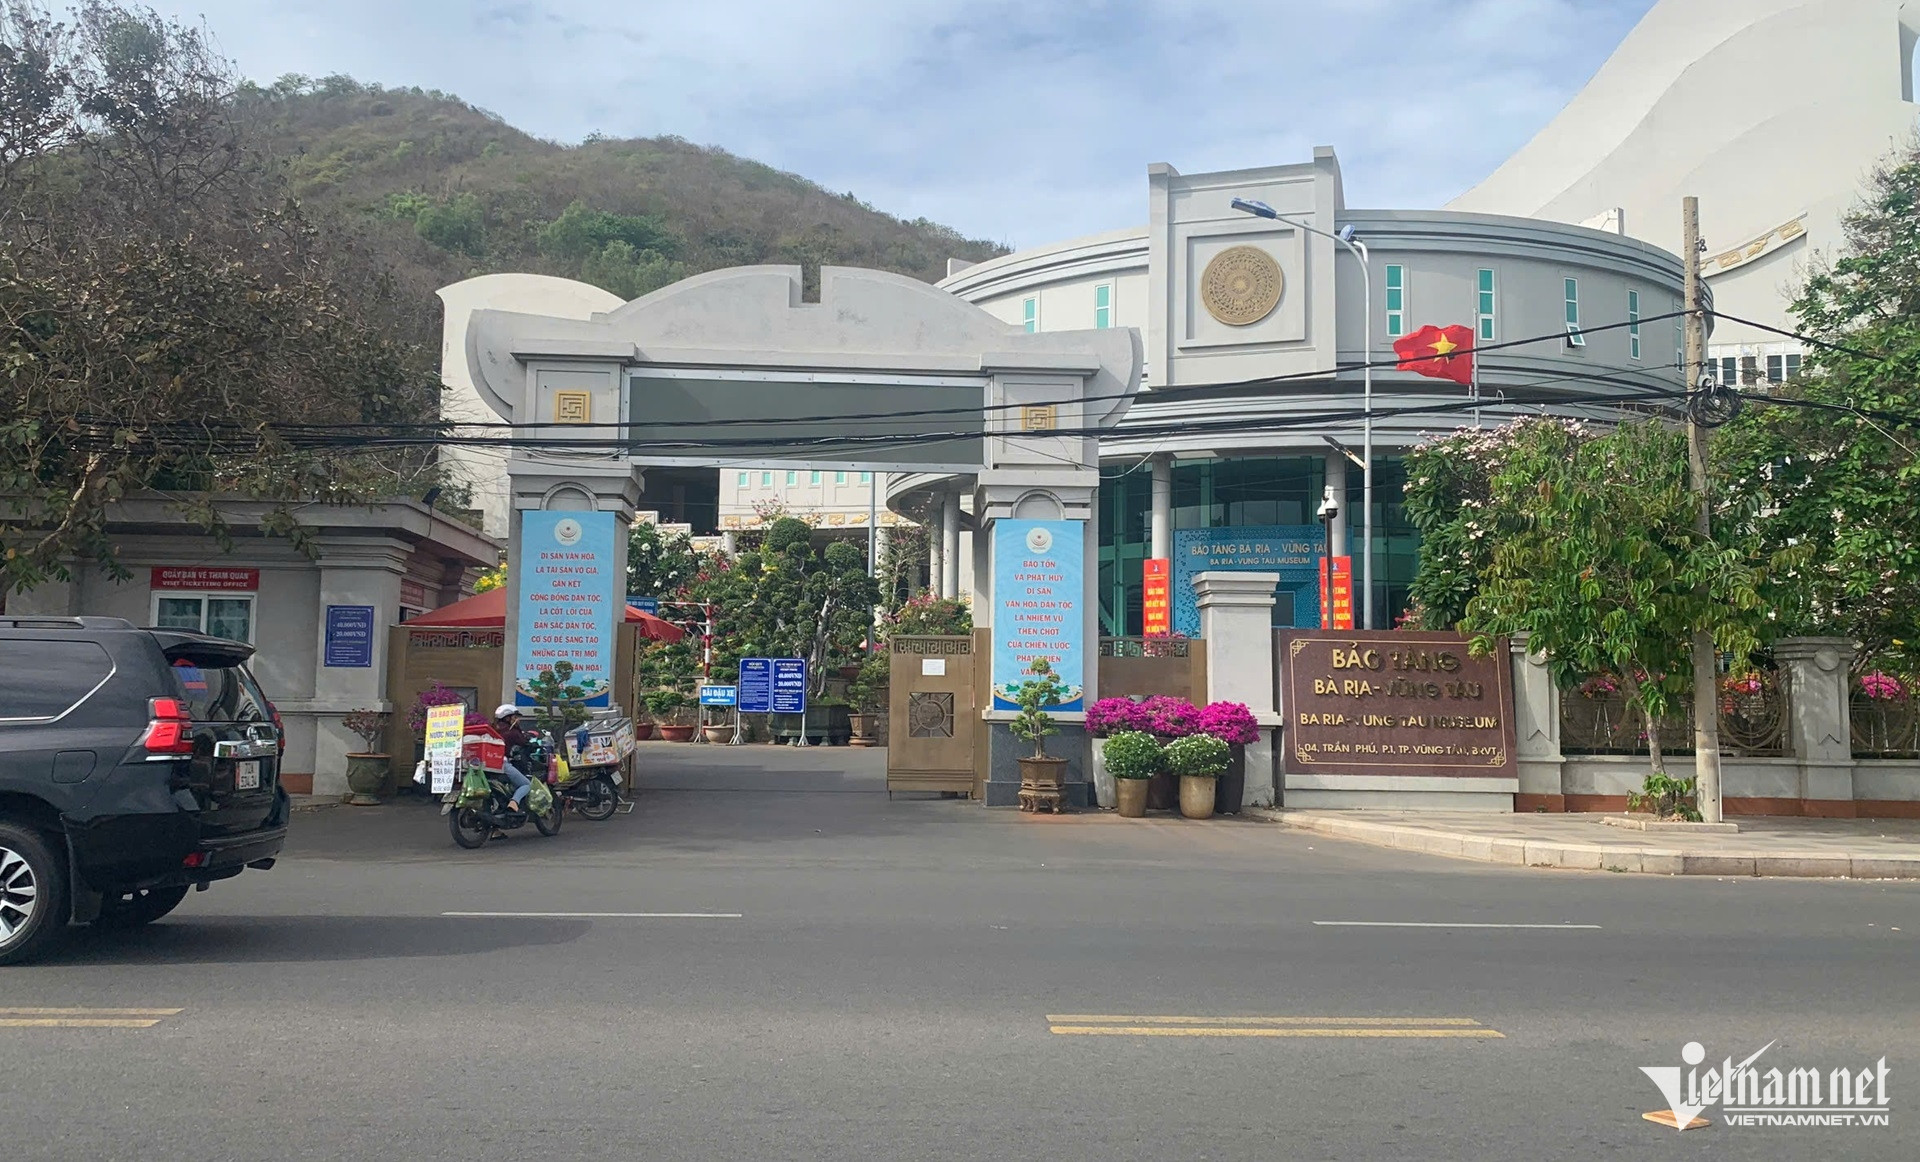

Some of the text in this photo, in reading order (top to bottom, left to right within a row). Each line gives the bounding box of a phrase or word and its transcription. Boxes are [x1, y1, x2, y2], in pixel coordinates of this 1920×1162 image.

[1212, 542, 1236, 554] TÀNG
[1256, 544, 1270, 556] RỊA
[1282, 541, 1310, 553] VŨNG
[209, 571, 228, 579] THAM
[1332, 641, 1380, 669] BẢO
[1314, 674, 1339, 695] BÀ
[702, 687, 735, 698] BÃI ĐẬU XE
[1300, 713, 1319, 725] BA
[1400, 715, 1429, 727] TAU
[1304, 743, 1320, 753] 04,
[1323, 741, 1350, 752] TRẦN
[1355, 742, 1378, 754] PHÚ,
[1399, 745, 1411, 754] TP.
[1413, 744, 1444, 755] VŨNG
